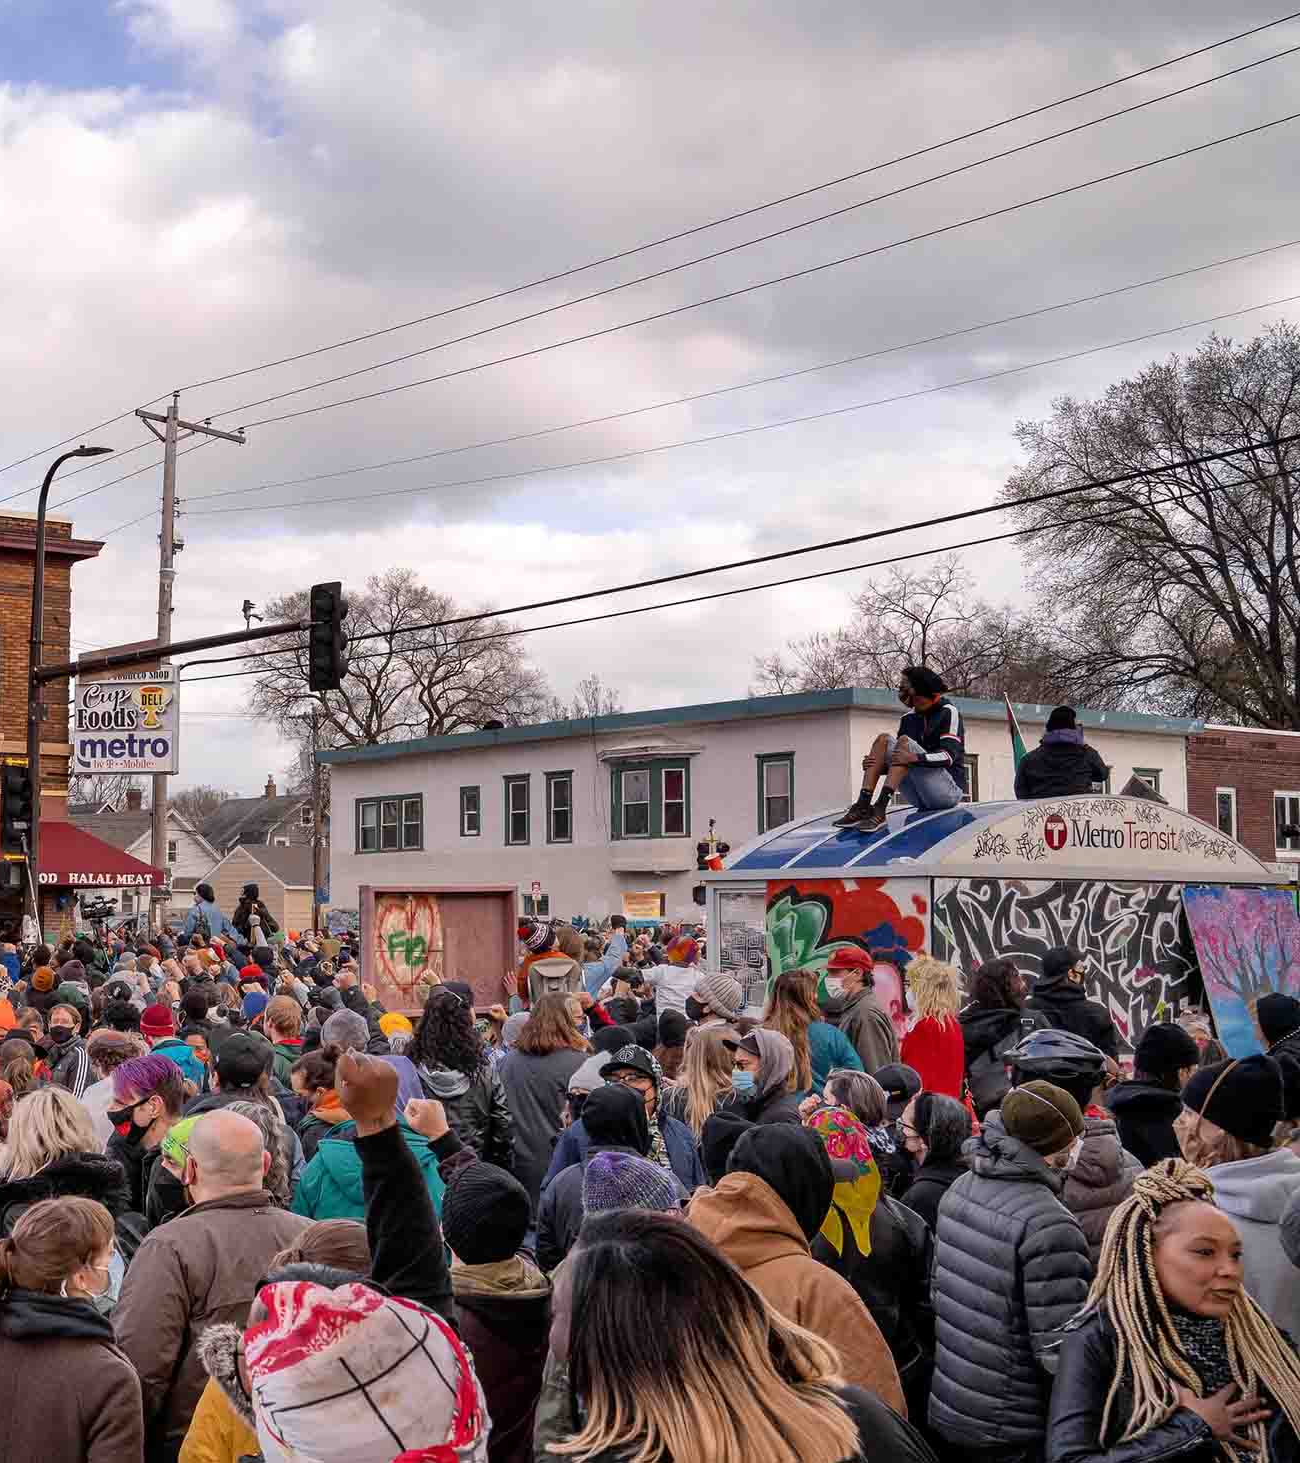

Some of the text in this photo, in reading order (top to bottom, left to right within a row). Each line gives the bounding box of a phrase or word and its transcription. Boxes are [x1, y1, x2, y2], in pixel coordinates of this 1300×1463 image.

[83, 684, 132, 711] Cup
[141, 694, 162, 706] DELI
[77, 707, 136, 729] Foods
[79, 733, 169, 758] metro
[68, 873, 113, 884] HALAL
[116, 874, 153, 884] MEAT
